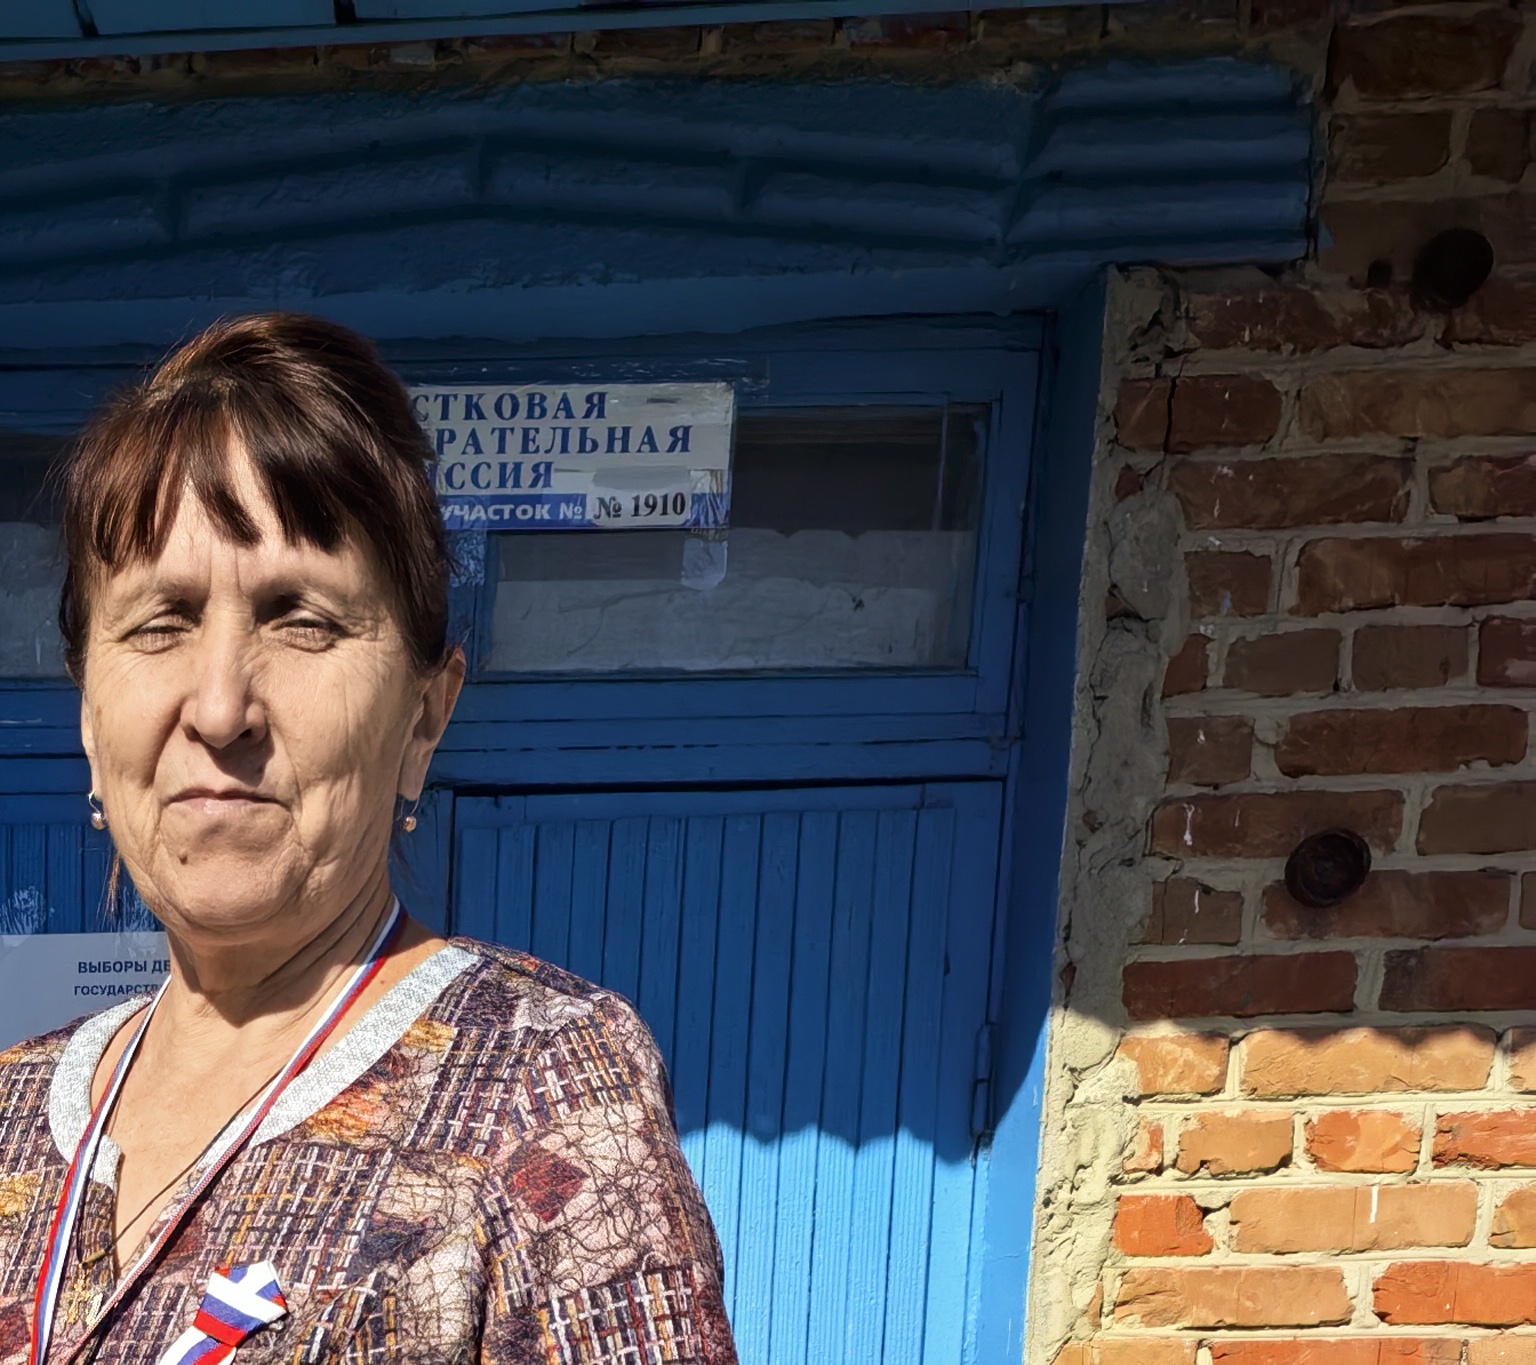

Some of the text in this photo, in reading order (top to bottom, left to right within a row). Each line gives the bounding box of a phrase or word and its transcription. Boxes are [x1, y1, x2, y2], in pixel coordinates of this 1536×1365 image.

[410, 391, 608, 422] СТКОВАЯ
[435, 425, 693, 456] РАТЕЛЬНАЯ
[439, 503, 551, 521] УЧАСТОК
[594, 495, 622, 520] №
[631, 491, 686, 517] 1910
[78, 960, 148, 974] ВЫБОРЫ
